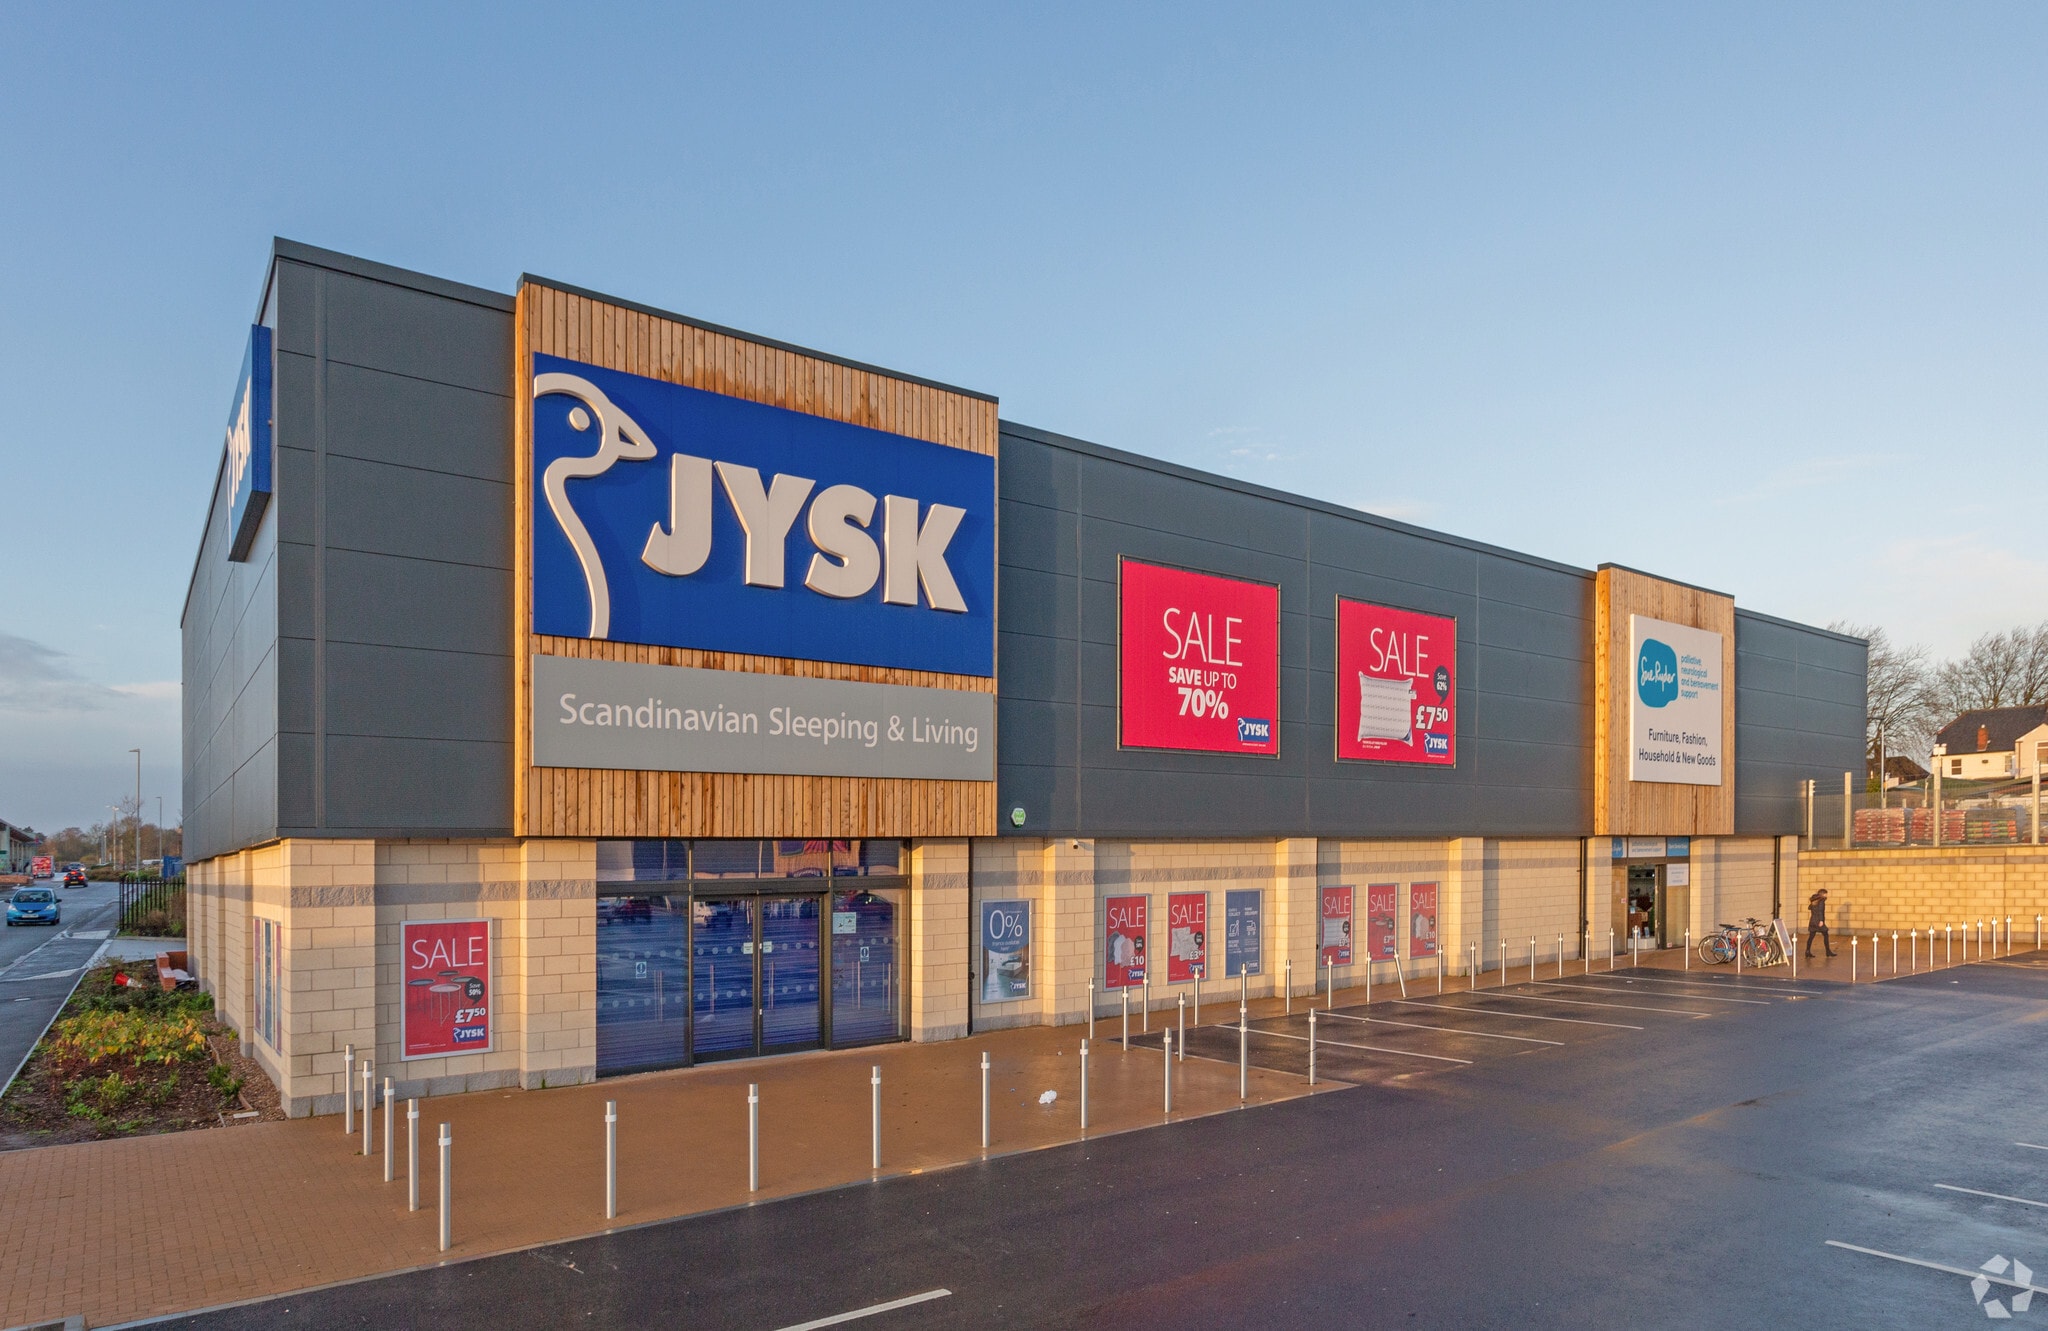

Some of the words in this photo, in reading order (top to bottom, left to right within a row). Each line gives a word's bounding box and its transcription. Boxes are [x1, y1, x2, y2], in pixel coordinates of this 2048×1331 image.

[641, 452, 969, 613] JYSK
[1162, 607, 1243, 667] SALE
[1370, 627, 1430, 678] SALE
[1168, 666, 1202, 686] SAVE
[1204, 670, 1219, 687] UP
[1220, 672, 1237, 690] TO
[1178, 687, 1229, 719] 70%
[559, 693, 758, 735] Scandinavian
[768, 707, 879, 748] Sleeping
[887, 716, 905, 742] &
[912, 717, 978, 753] Living
[1244, 723, 1269, 737] JYSK
[1429, 738, 1448, 750] JYSK
[1649, 728, 1681, 745] Furniture,
[1681, 731, 1708, 747] Fashion,
[1639, 748, 1675, 763] Household
[1675, 751, 1681, 763] &
[1682, 752, 1696, 764] New
[1697, 753, 1716, 767] Goods
[1324, 896, 1350, 915] SALE
[1370, 894, 1395, 912] SALE
[1412, 892, 1436, 910] SALE
[989, 910, 1023, 939] 0%
[1109, 906, 1144, 929] SALE
[1171, 904, 1204, 925] SALE
[412, 936, 484, 970] SALE
[1130, 955, 1145, 966] £10
[459, 1027, 485, 1038] JYSK
